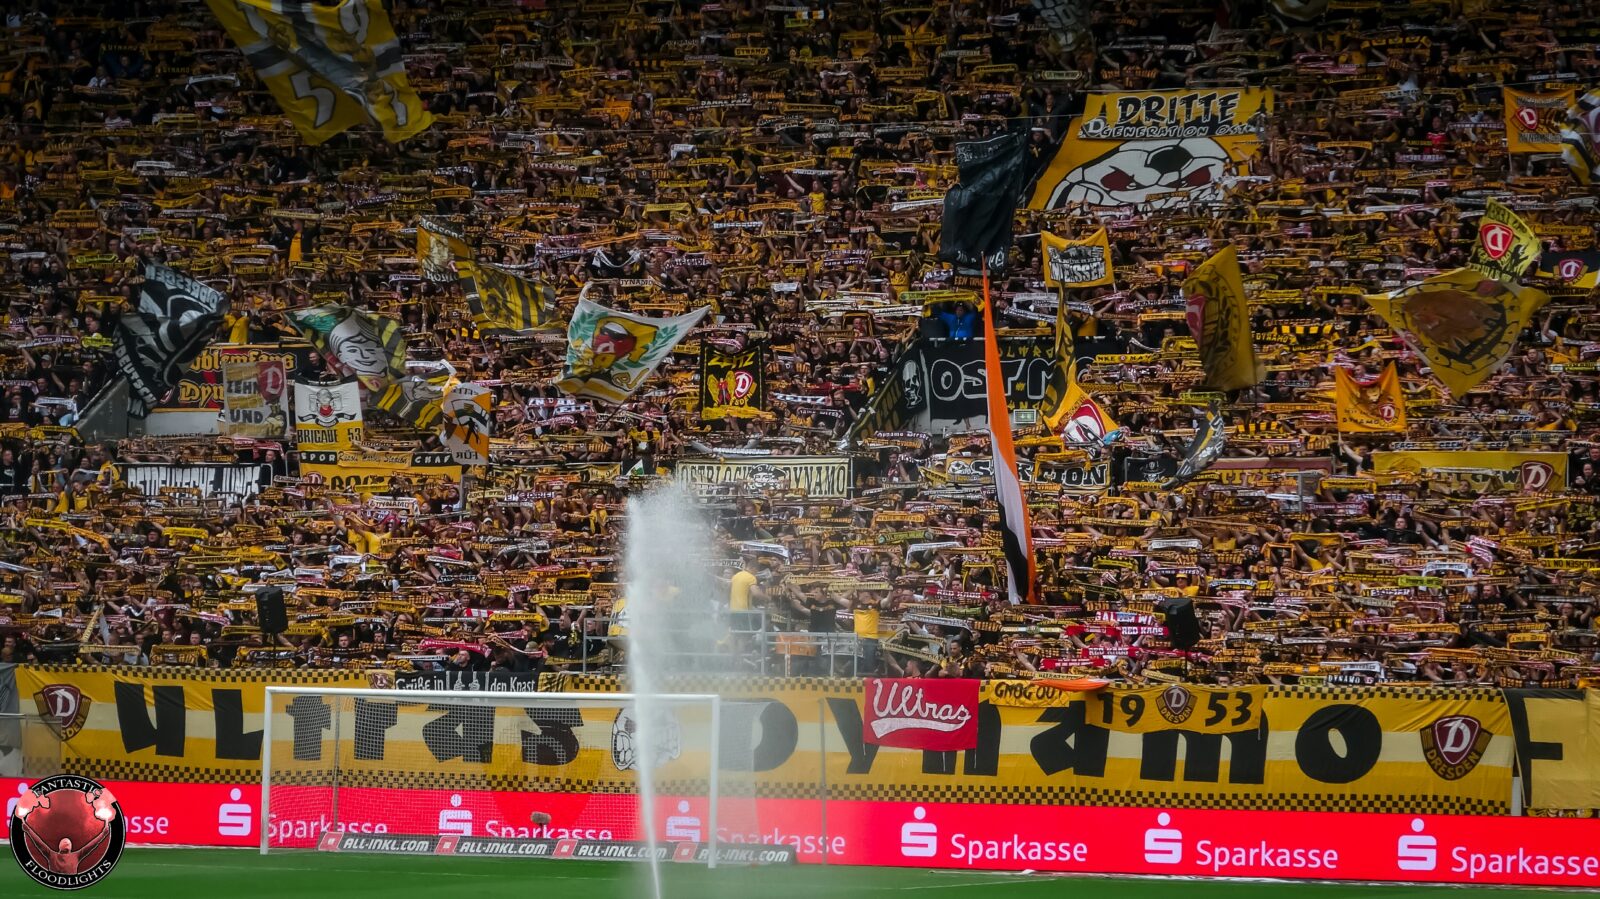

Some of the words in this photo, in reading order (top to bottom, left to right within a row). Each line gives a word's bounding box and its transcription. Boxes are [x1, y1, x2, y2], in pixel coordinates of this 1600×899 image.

[1117, 91, 1240, 124] DRITTE
[1100, 124, 1209, 137] GENERATION
[230, 409, 264, 424] UND
[297, 429, 338, 444] BRIGADE
[348, 427, 361, 442] 53
[301, 452, 336, 462] SPOR
[414, 454, 450, 464] CHAF
[1121, 626, 1139, 635] RED
[1140, 626, 1164, 635] KAOS
[510, 676, 536, 692] Knast
[1328, 674, 1361, 684] DYNAMO
[872, 678, 972, 719] Ultras
[1098, 691, 1146, 727] 19
[1204, 690, 1253, 727] 53
[1160, 707, 1192, 723] DRESDEN
[1442, 717, 1471, 753] D
[1426, 750, 1481, 780] DRESDEN
[950, 833, 1088, 865] Sparkasse
[1195, 840, 1339, 872] Sparkasse
[1450, 846, 1599, 878] Sparkasse
